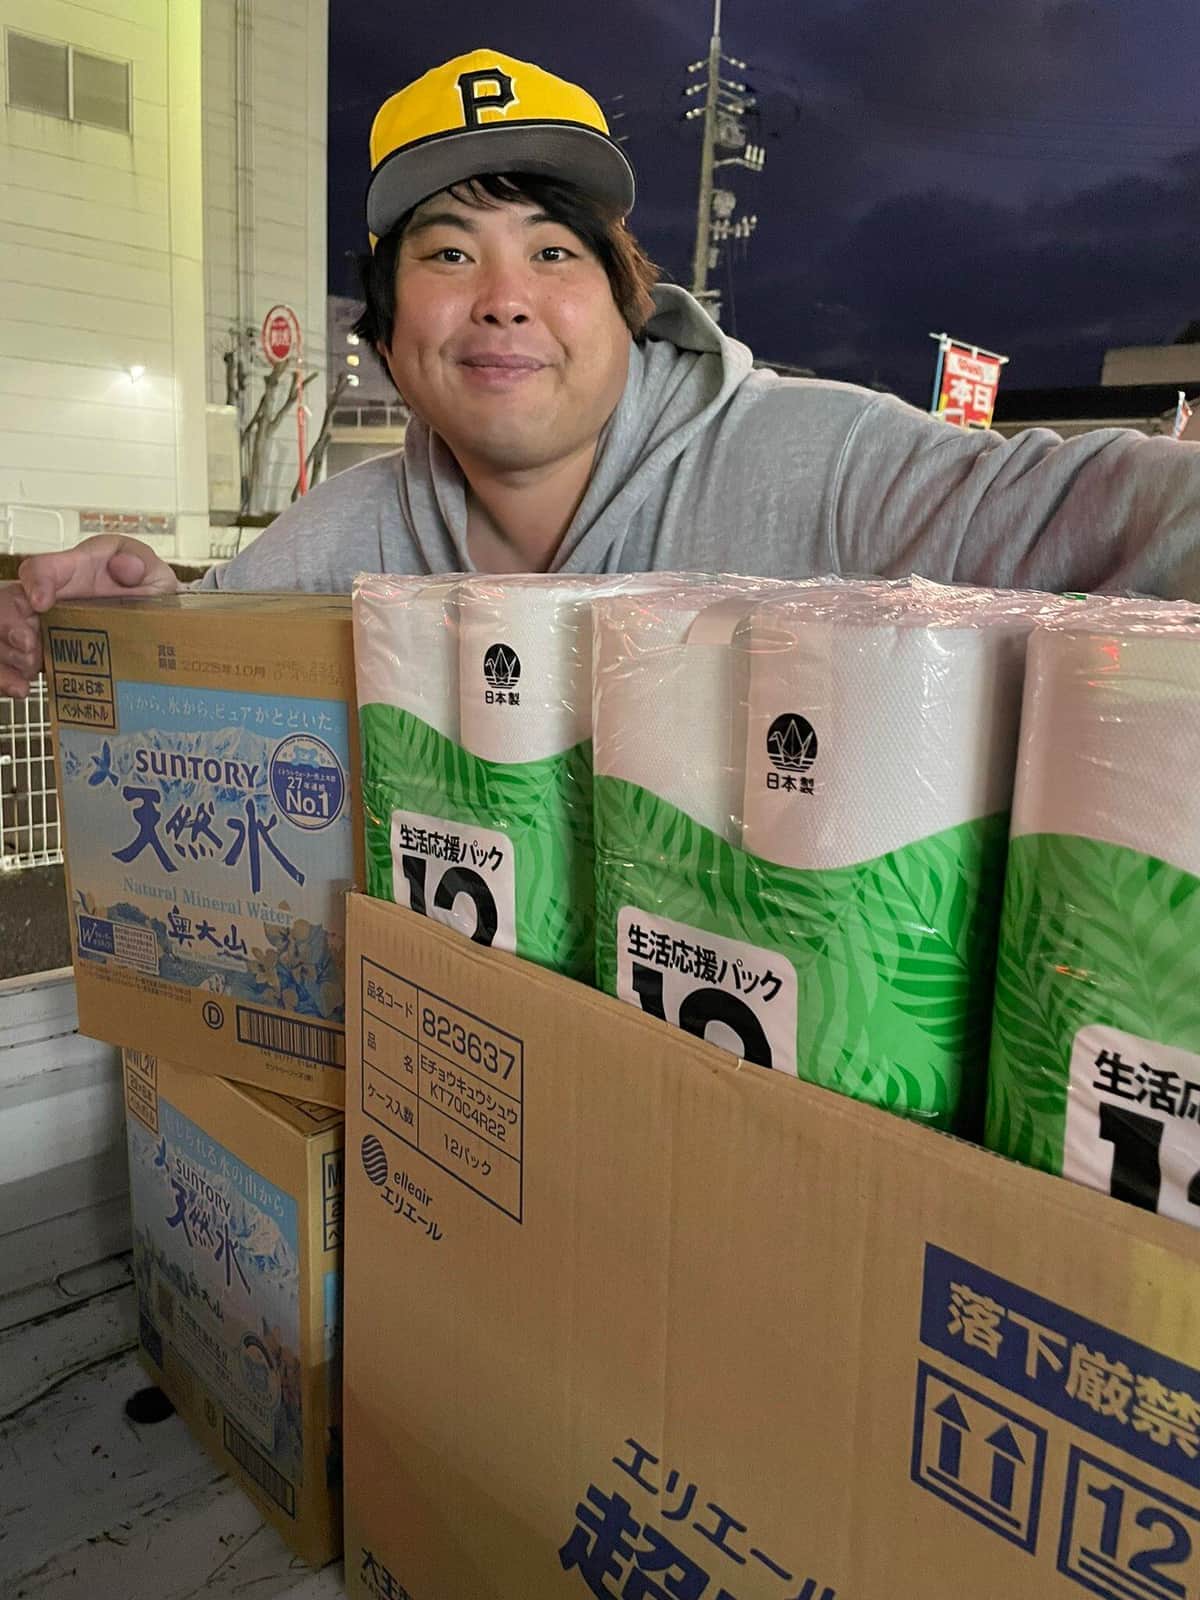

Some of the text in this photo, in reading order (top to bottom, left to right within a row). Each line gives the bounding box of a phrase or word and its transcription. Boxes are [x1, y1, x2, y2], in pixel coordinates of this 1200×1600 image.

[456, 66, 517, 127] P
[51, 638, 106, 666] MWL2Y
[62, 703, 109, 721] ペットボトル
[484, 691, 520, 706] 日本製
[286, 789, 330, 817] No.1
[766, 772, 815, 796] 日本製
[112, 786, 305, 895] 天然水
[398, 823, 504, 871] 生活応援パック
[122, 877, 293, 926] Natural Mineral Water
[168, 905, 248, 954] 奥大山
[627, 924, 783, 1002] 生活応援パック
[367, 980, 415, 1018] 品名コード
[422, 1007, 515, 1080] 823637
[367, 1082, 415, 1127] ケース入数
[420, 1055, 518, 1126] Eチョウキュウシュウ
[430, 1079, 506, 1142] KT70C4R22
[443, 1133, 492, 1177] 12パック
[380, 1185, 443, 1242] エリエール
[393, 1171, 433, 1207] elleair
[165, 1178, 251, 1297] 天然水
[947, 1281, 1200, 1459] 落下厳禁
[1086, 1482, 1193, 1599] 12
